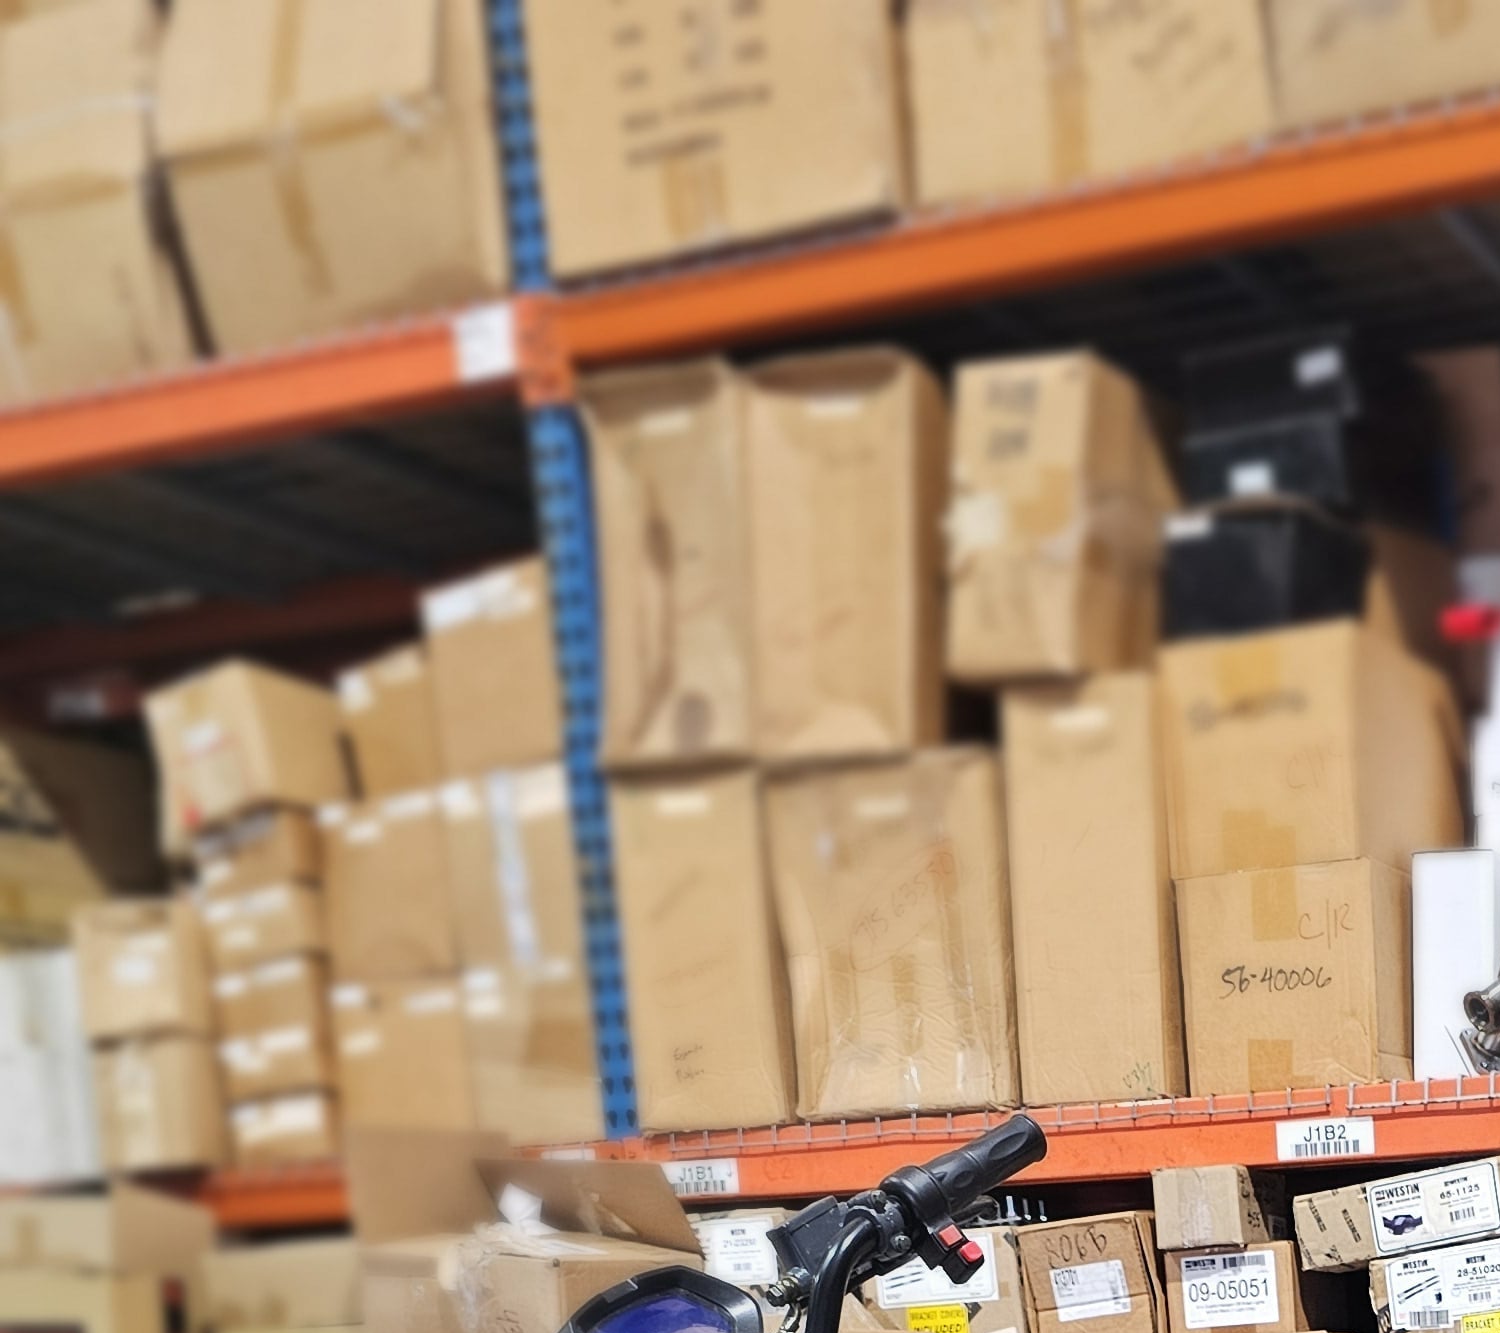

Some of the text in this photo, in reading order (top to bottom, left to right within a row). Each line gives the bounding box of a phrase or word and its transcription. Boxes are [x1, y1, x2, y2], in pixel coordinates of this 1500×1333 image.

[1218, 965, 1333, 1000] 56-40006
[1303, 1124, 1348, 1143] J1B2
[679, 1166, 714, 1182] J1B1
[1385, 1183, 1420, 1199] WESTIN
[1440, 1184, 1480, 1199] 65-1125
[1402, 1260, 1428, 1270] WESTIN
[1188, 1278, 1270, 1303] 09-05051
[1465, 1317, 1495, 1331] BRACKET
